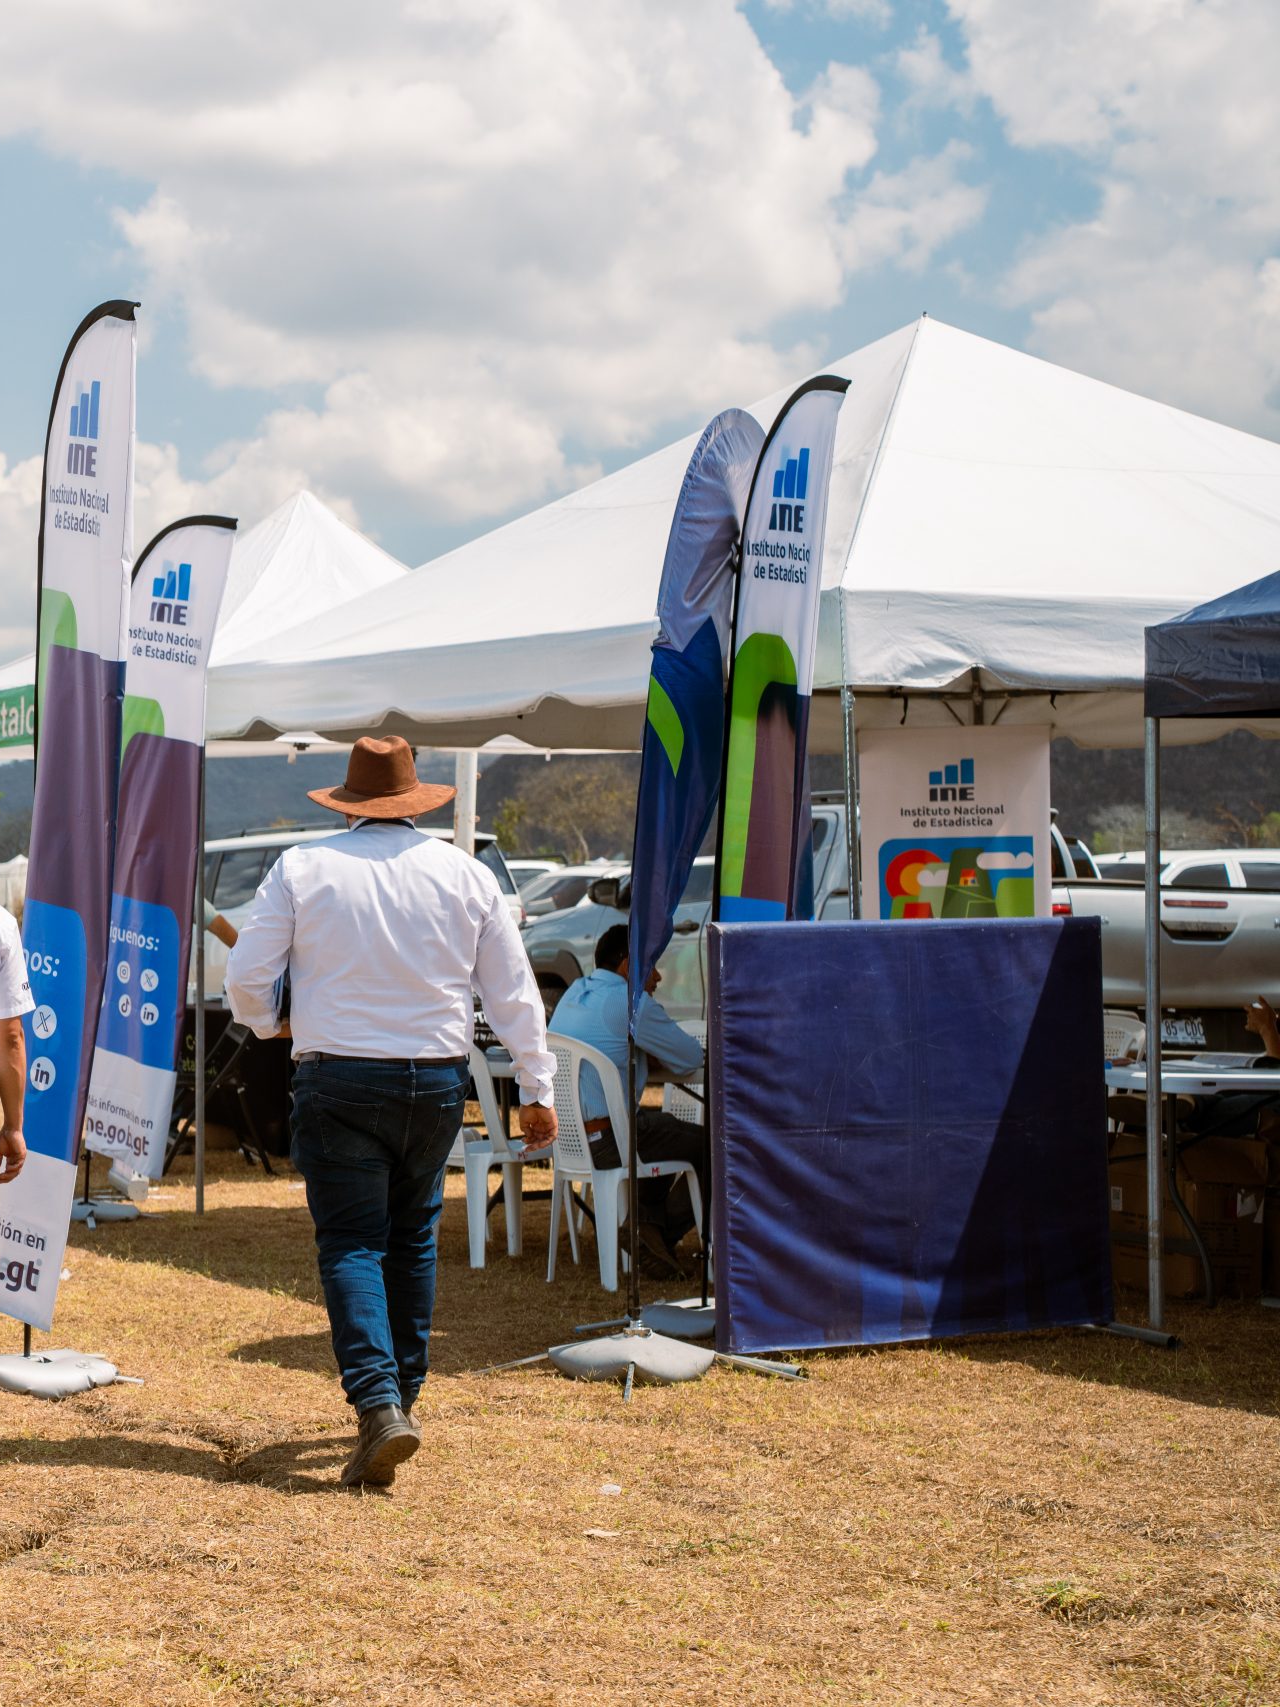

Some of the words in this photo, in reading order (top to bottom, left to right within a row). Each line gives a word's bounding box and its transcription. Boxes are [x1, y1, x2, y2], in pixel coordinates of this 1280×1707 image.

[67, 443, 98, 478] INE
[49, 483, 78, 505] Instituto
[55, 508, 62, 528] de
[769, 503, 805, 533] INE
[754, 560, 766, 579] de
[768, 563, 807, 585] Estadísti
[149, 601, 188, 626] INE
[127, 626, 163, 642] nstituto
[132, 643, 142, 656] de
[929, 786, 975, 802] INE
[900, 805, 950, 817] Instituto
[953, 804, 1005, 815] Nacional
[913, 818, 927, 828] de
[141, 1118, 153, 1130] en
[86, 1117, 150, 1156] ne.gob.gt
[26, 1234, 45, 1251] en
